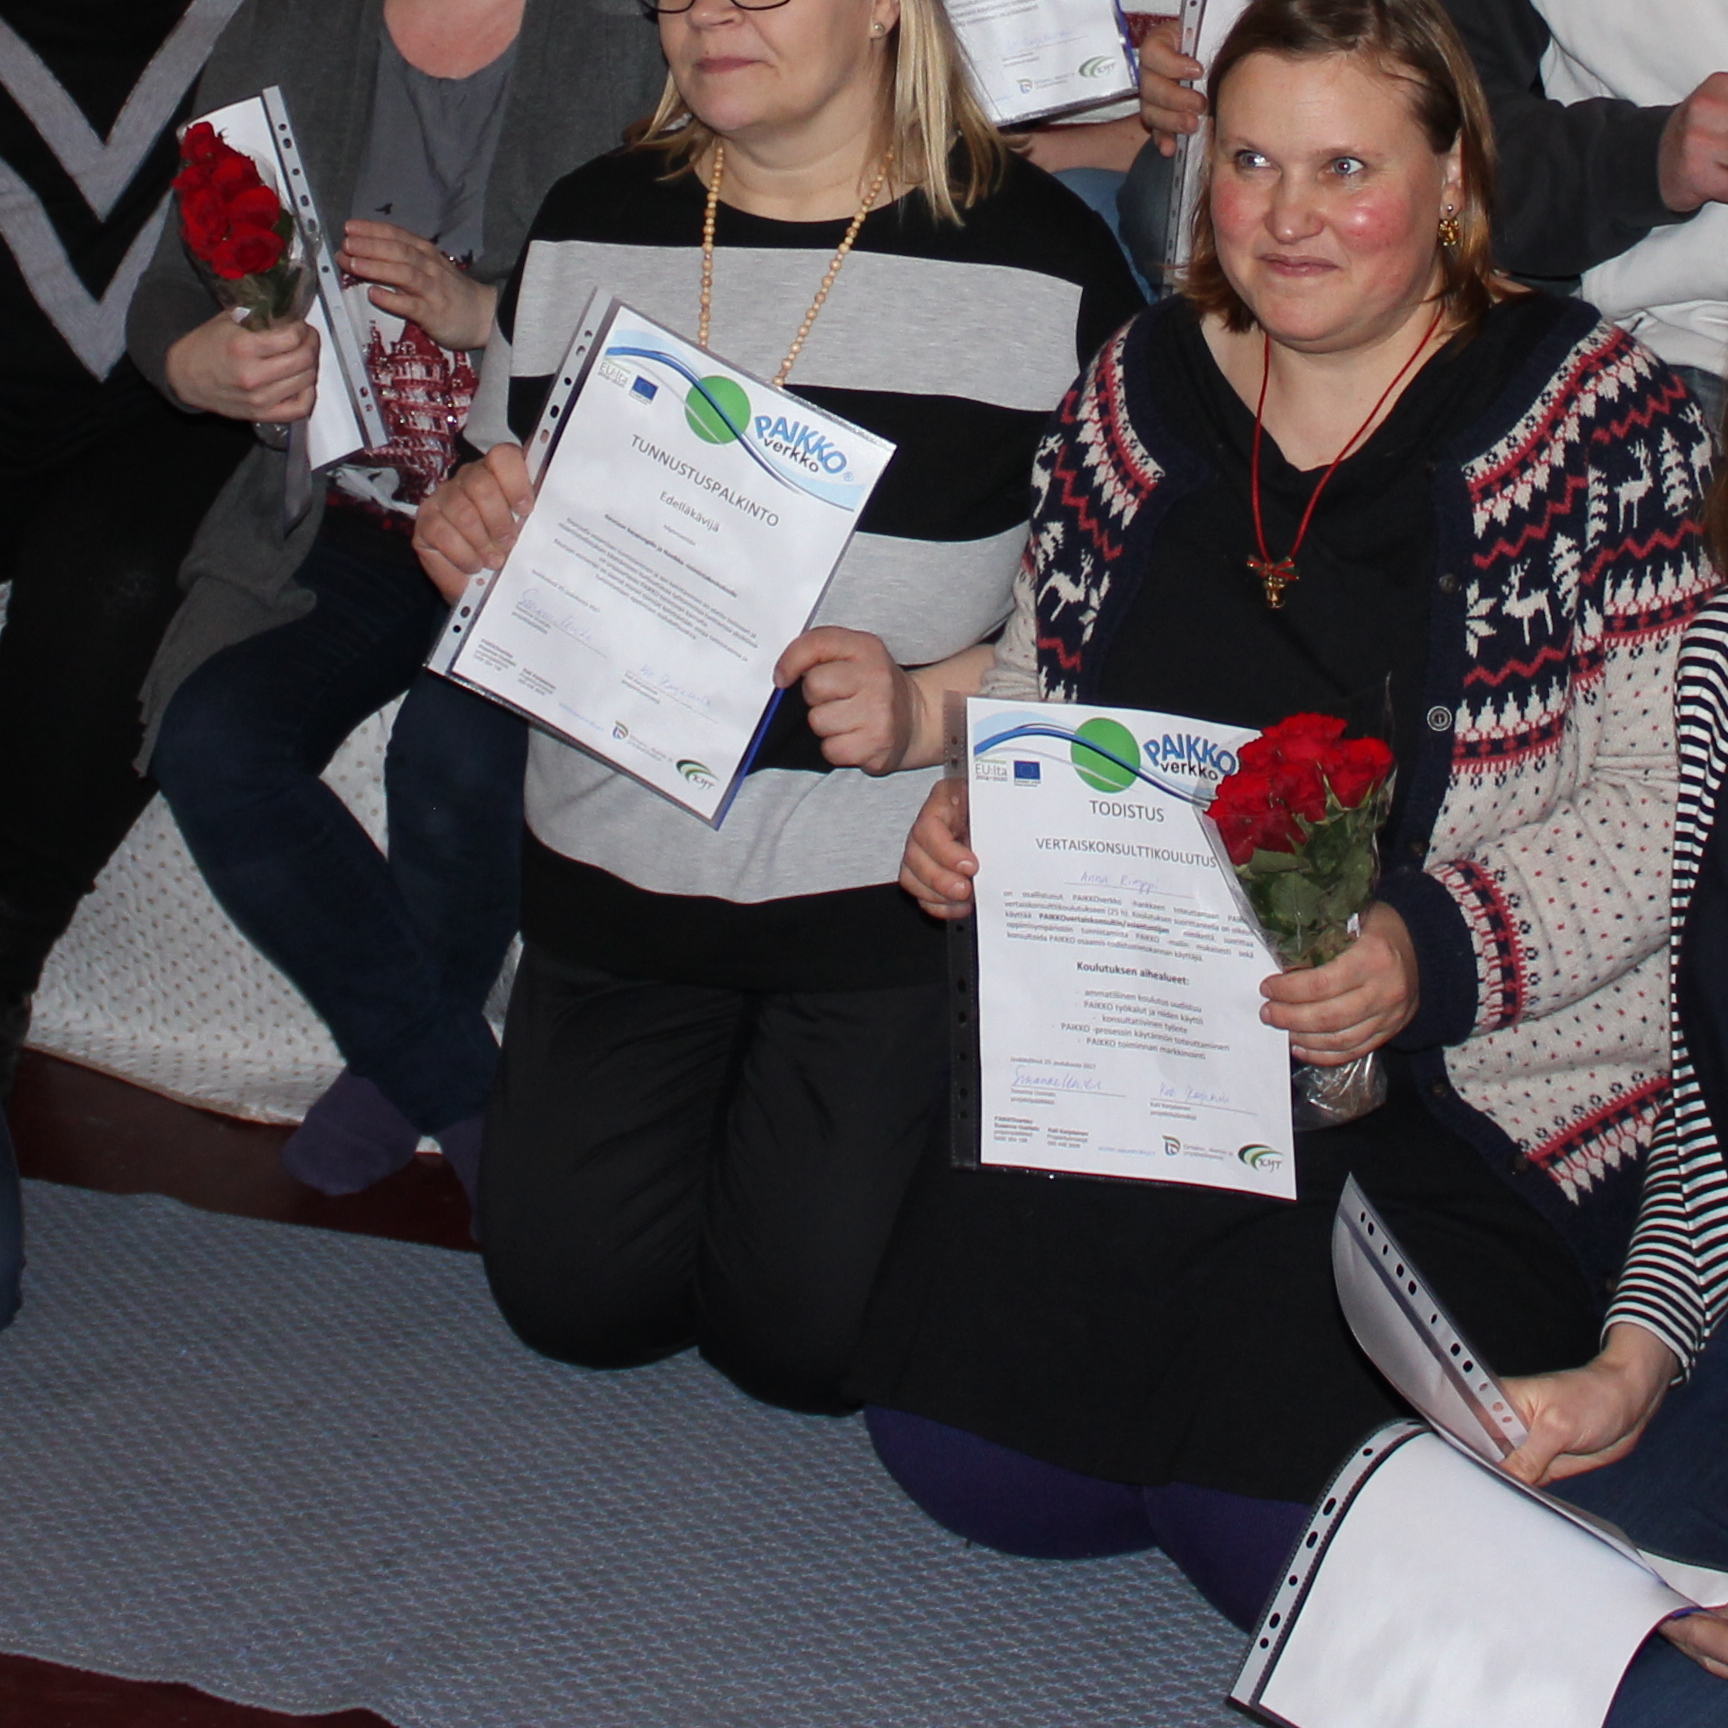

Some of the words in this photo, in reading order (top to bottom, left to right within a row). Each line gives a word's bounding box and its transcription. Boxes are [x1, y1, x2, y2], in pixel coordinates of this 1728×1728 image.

[754, 415, 847, 475] PAIKKO
[763, 438, 819, 473] verkko
[631, 433, 781, 528] TUNNUSTUSPALKINTO
[659, 490, 721, 534] Edelläkävijä
[1143, 733, 1237, 776] PAIKKO
[1160, 753, 1219, 781] verkko
[975, 763, 1008, 776] EU:lta
[1088, 799, 1165, 822] TODISTUS
[1035, 837, 1219, 869] VERTAISKONSULTTIKOULUTUS
[1076, 961, 1137, 977] Koulutuksen
[1138, 969, 1190, 985] aihealueet:
[1083, 1000, 1113, 1011] PAIKKO
[1114, 1004, 1147, 1016] työkalut
[1148, 1009, 1156, 1017] ja
[1060, 1022, 1090, 1033] PAIKKO
[1086, 1037, 1115, 1047] PAIKKO
